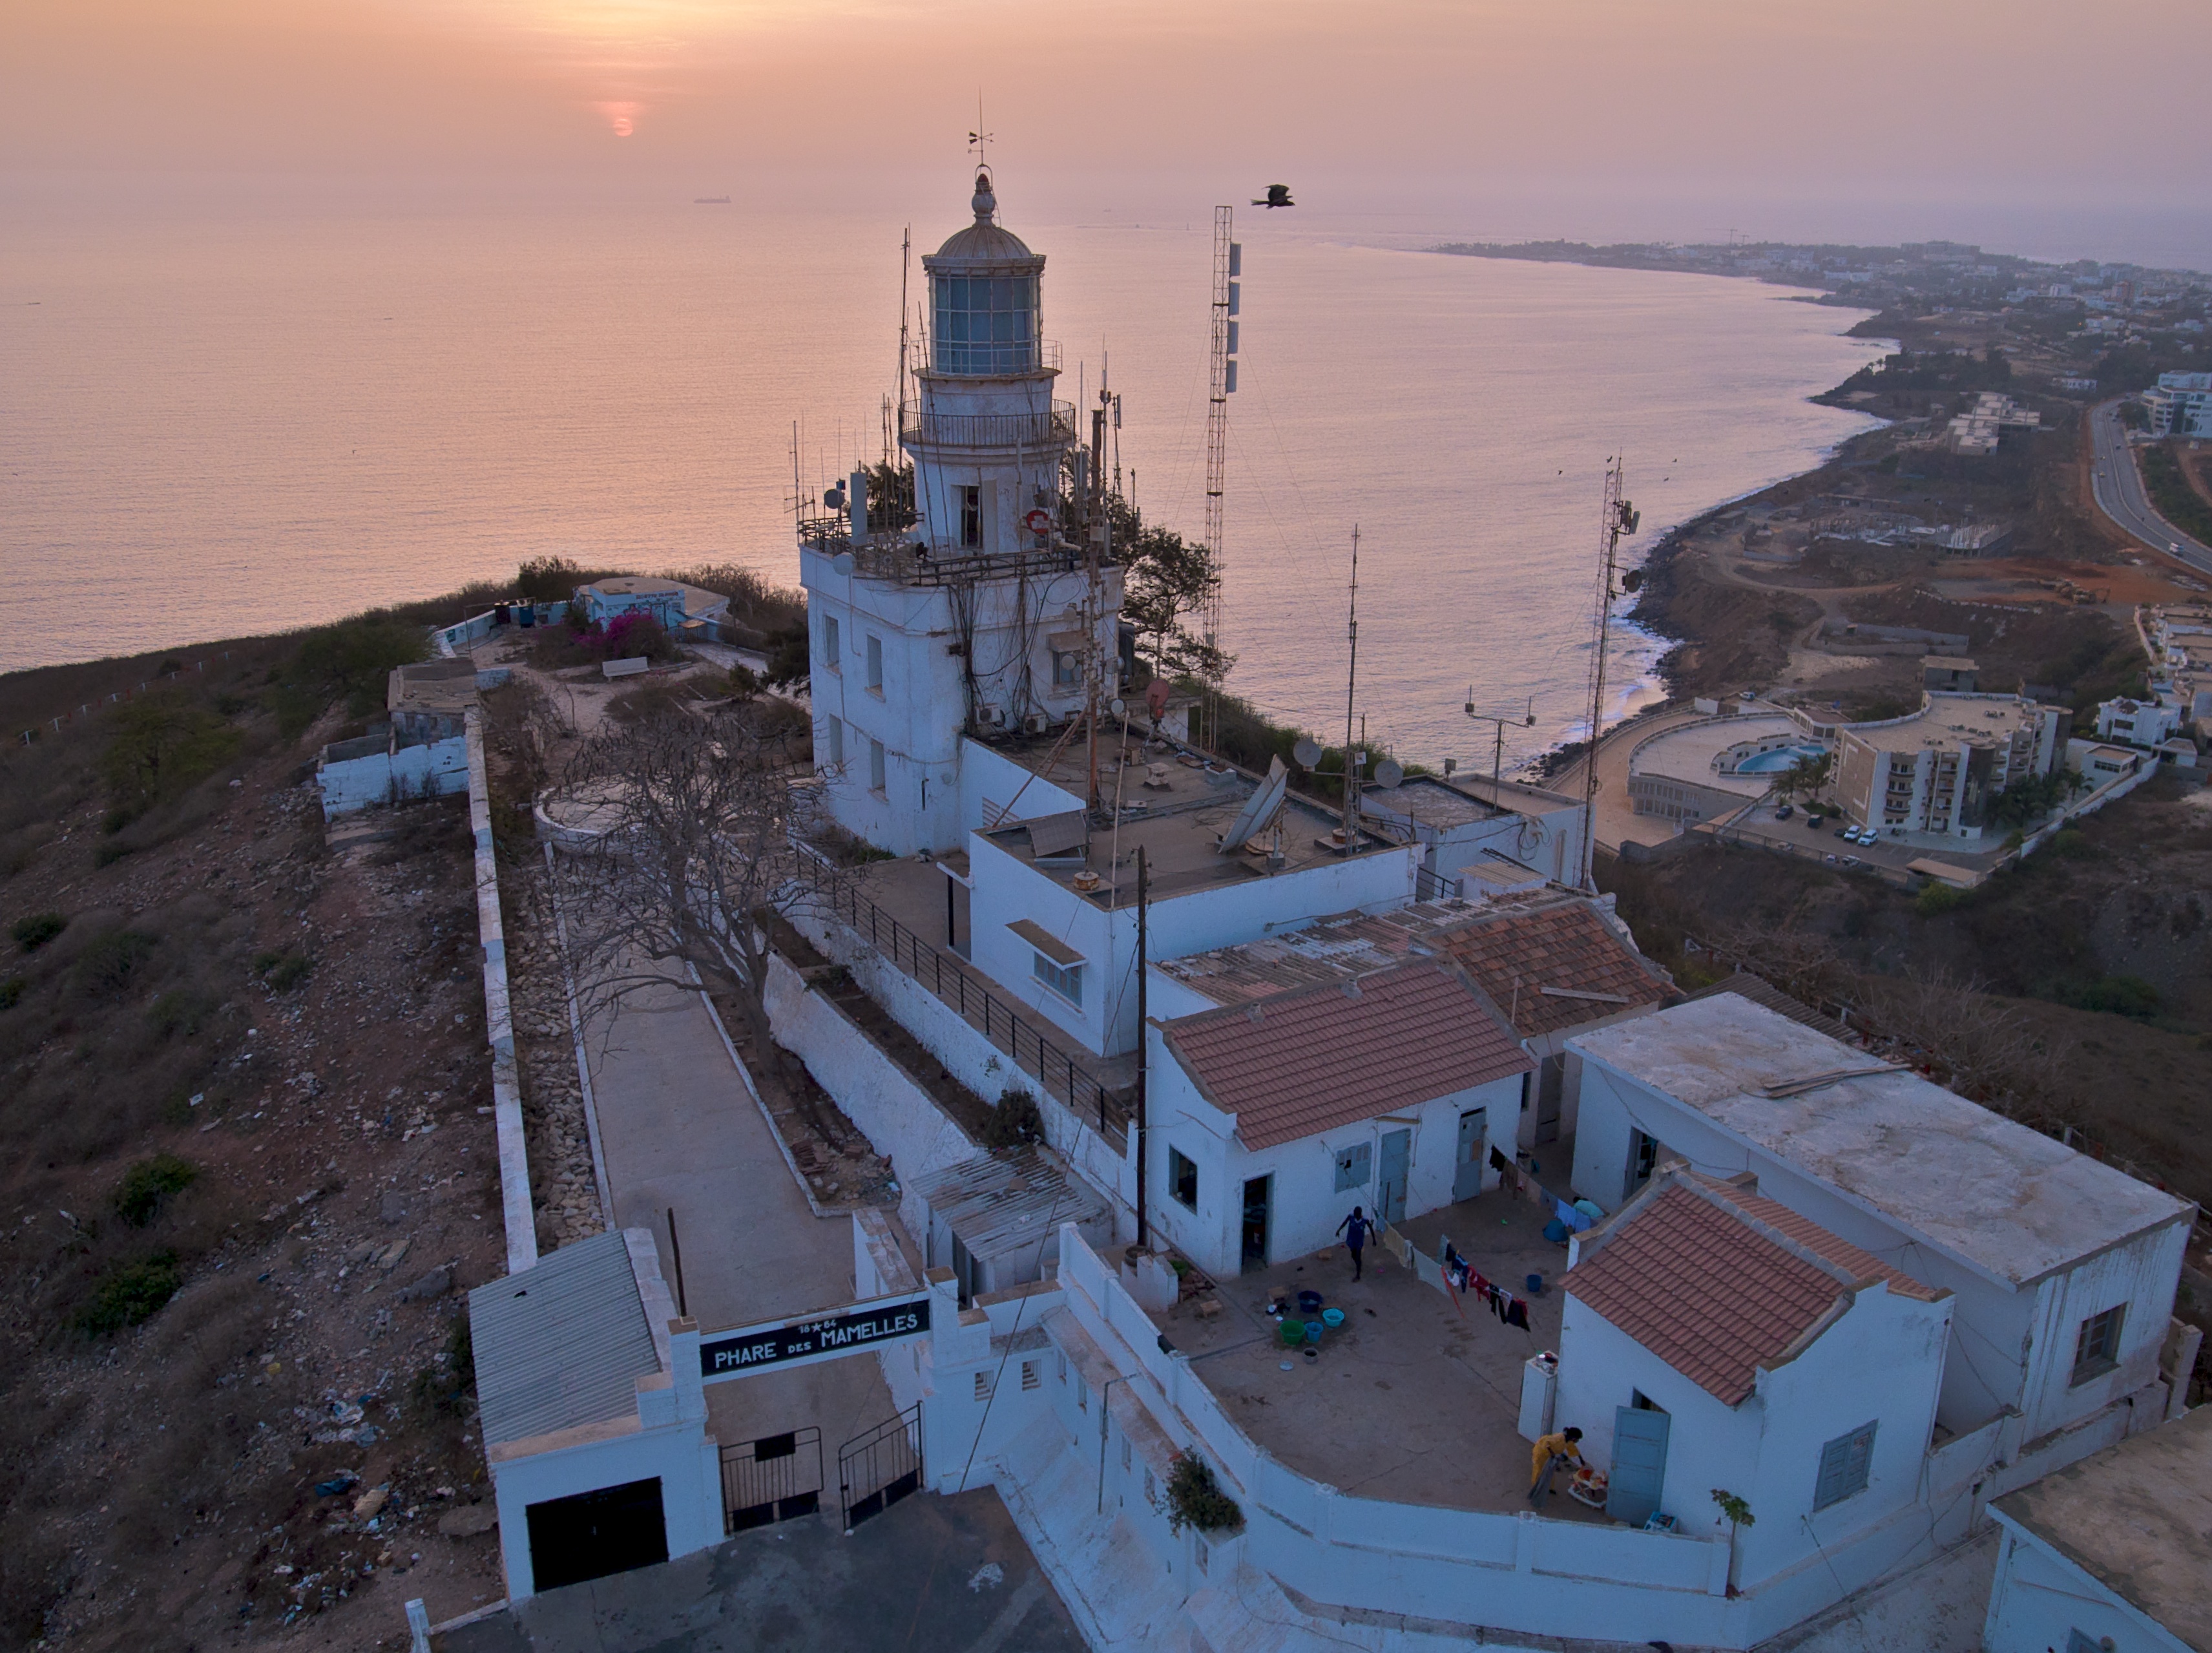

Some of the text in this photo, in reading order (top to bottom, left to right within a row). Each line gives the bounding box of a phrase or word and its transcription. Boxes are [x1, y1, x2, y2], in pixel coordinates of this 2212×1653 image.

[715, 1314, 918, 1369] PHARE DES MAMELLES
